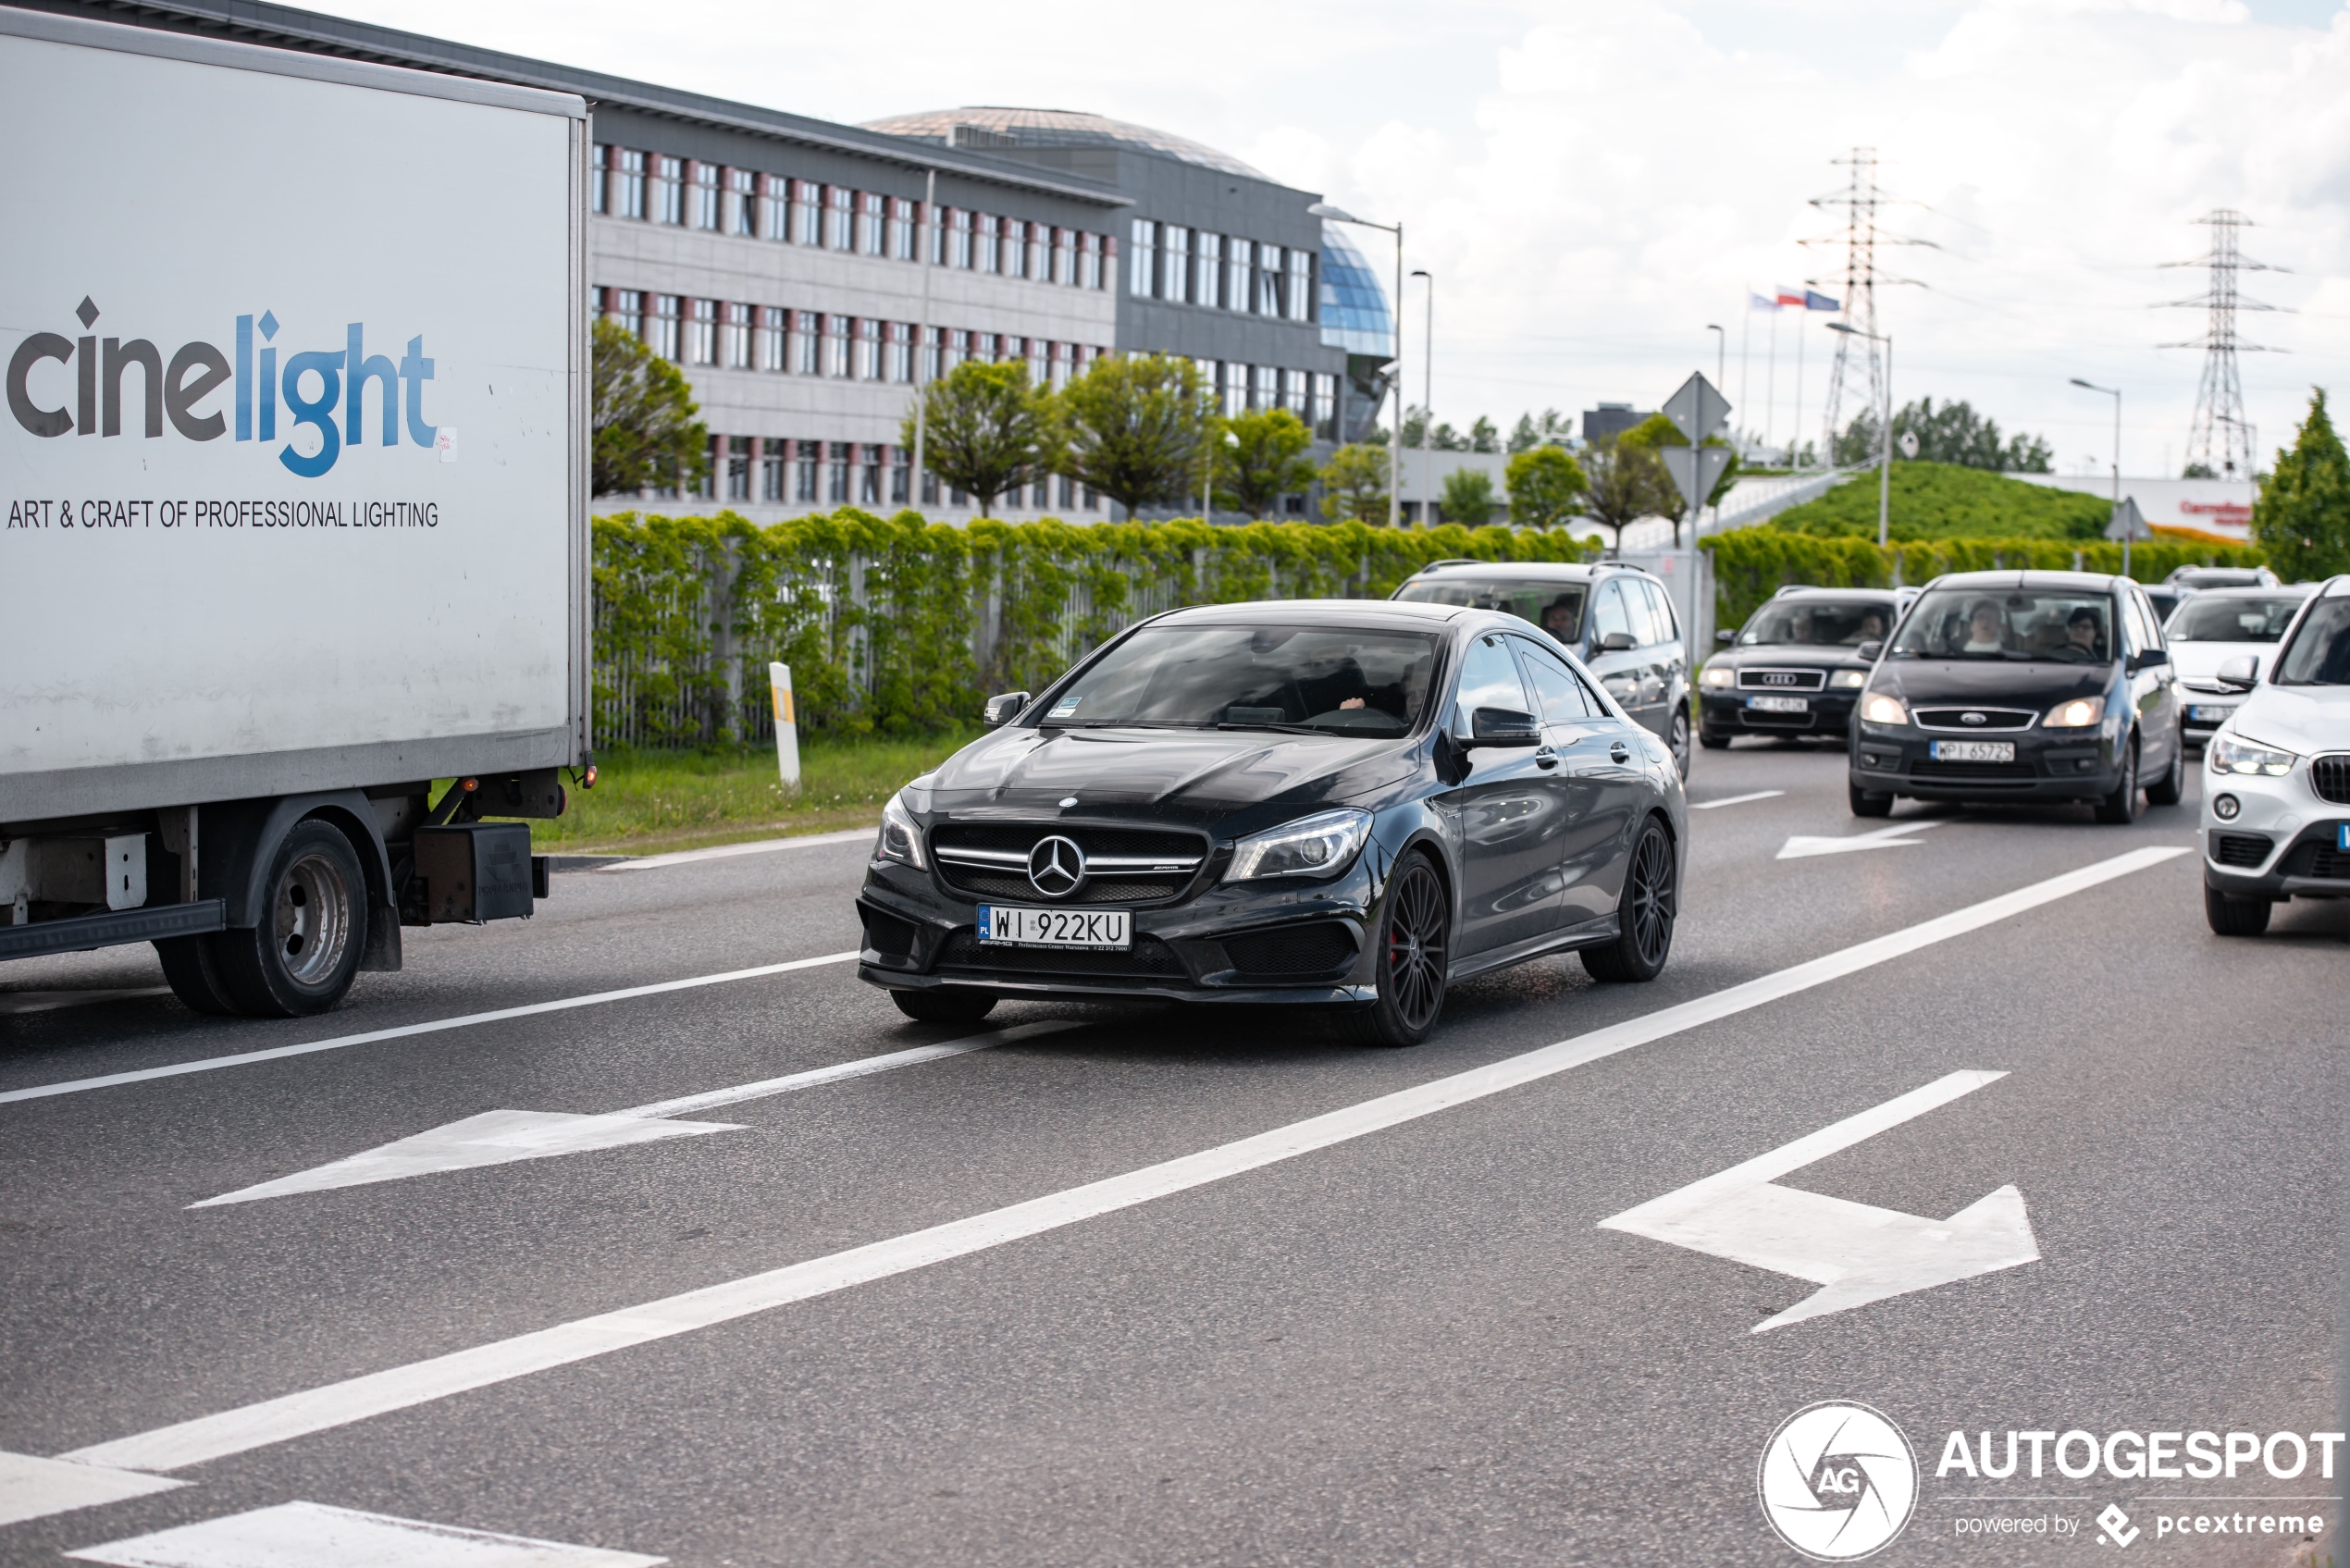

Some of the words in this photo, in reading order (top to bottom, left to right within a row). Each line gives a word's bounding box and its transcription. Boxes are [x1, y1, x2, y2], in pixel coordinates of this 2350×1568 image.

[6, 295, 438, 477] cinelight
[7, 500, 53, 528] ART
[60, 500, 74, 527] &
[80, 500, 154, 527] CRAFT
[160, 500, 188, 527] OF
[195, 500, 348, 527] PROFESSIONAL
[352, 501, 439, 527] LIGHTING
[1939, 744, 1962, 759] WPI
[1970, 744, 2013, 759] 65725
[996, 910, 1022, 939] WI
[1037, 913, 1122, 942] 922KU
